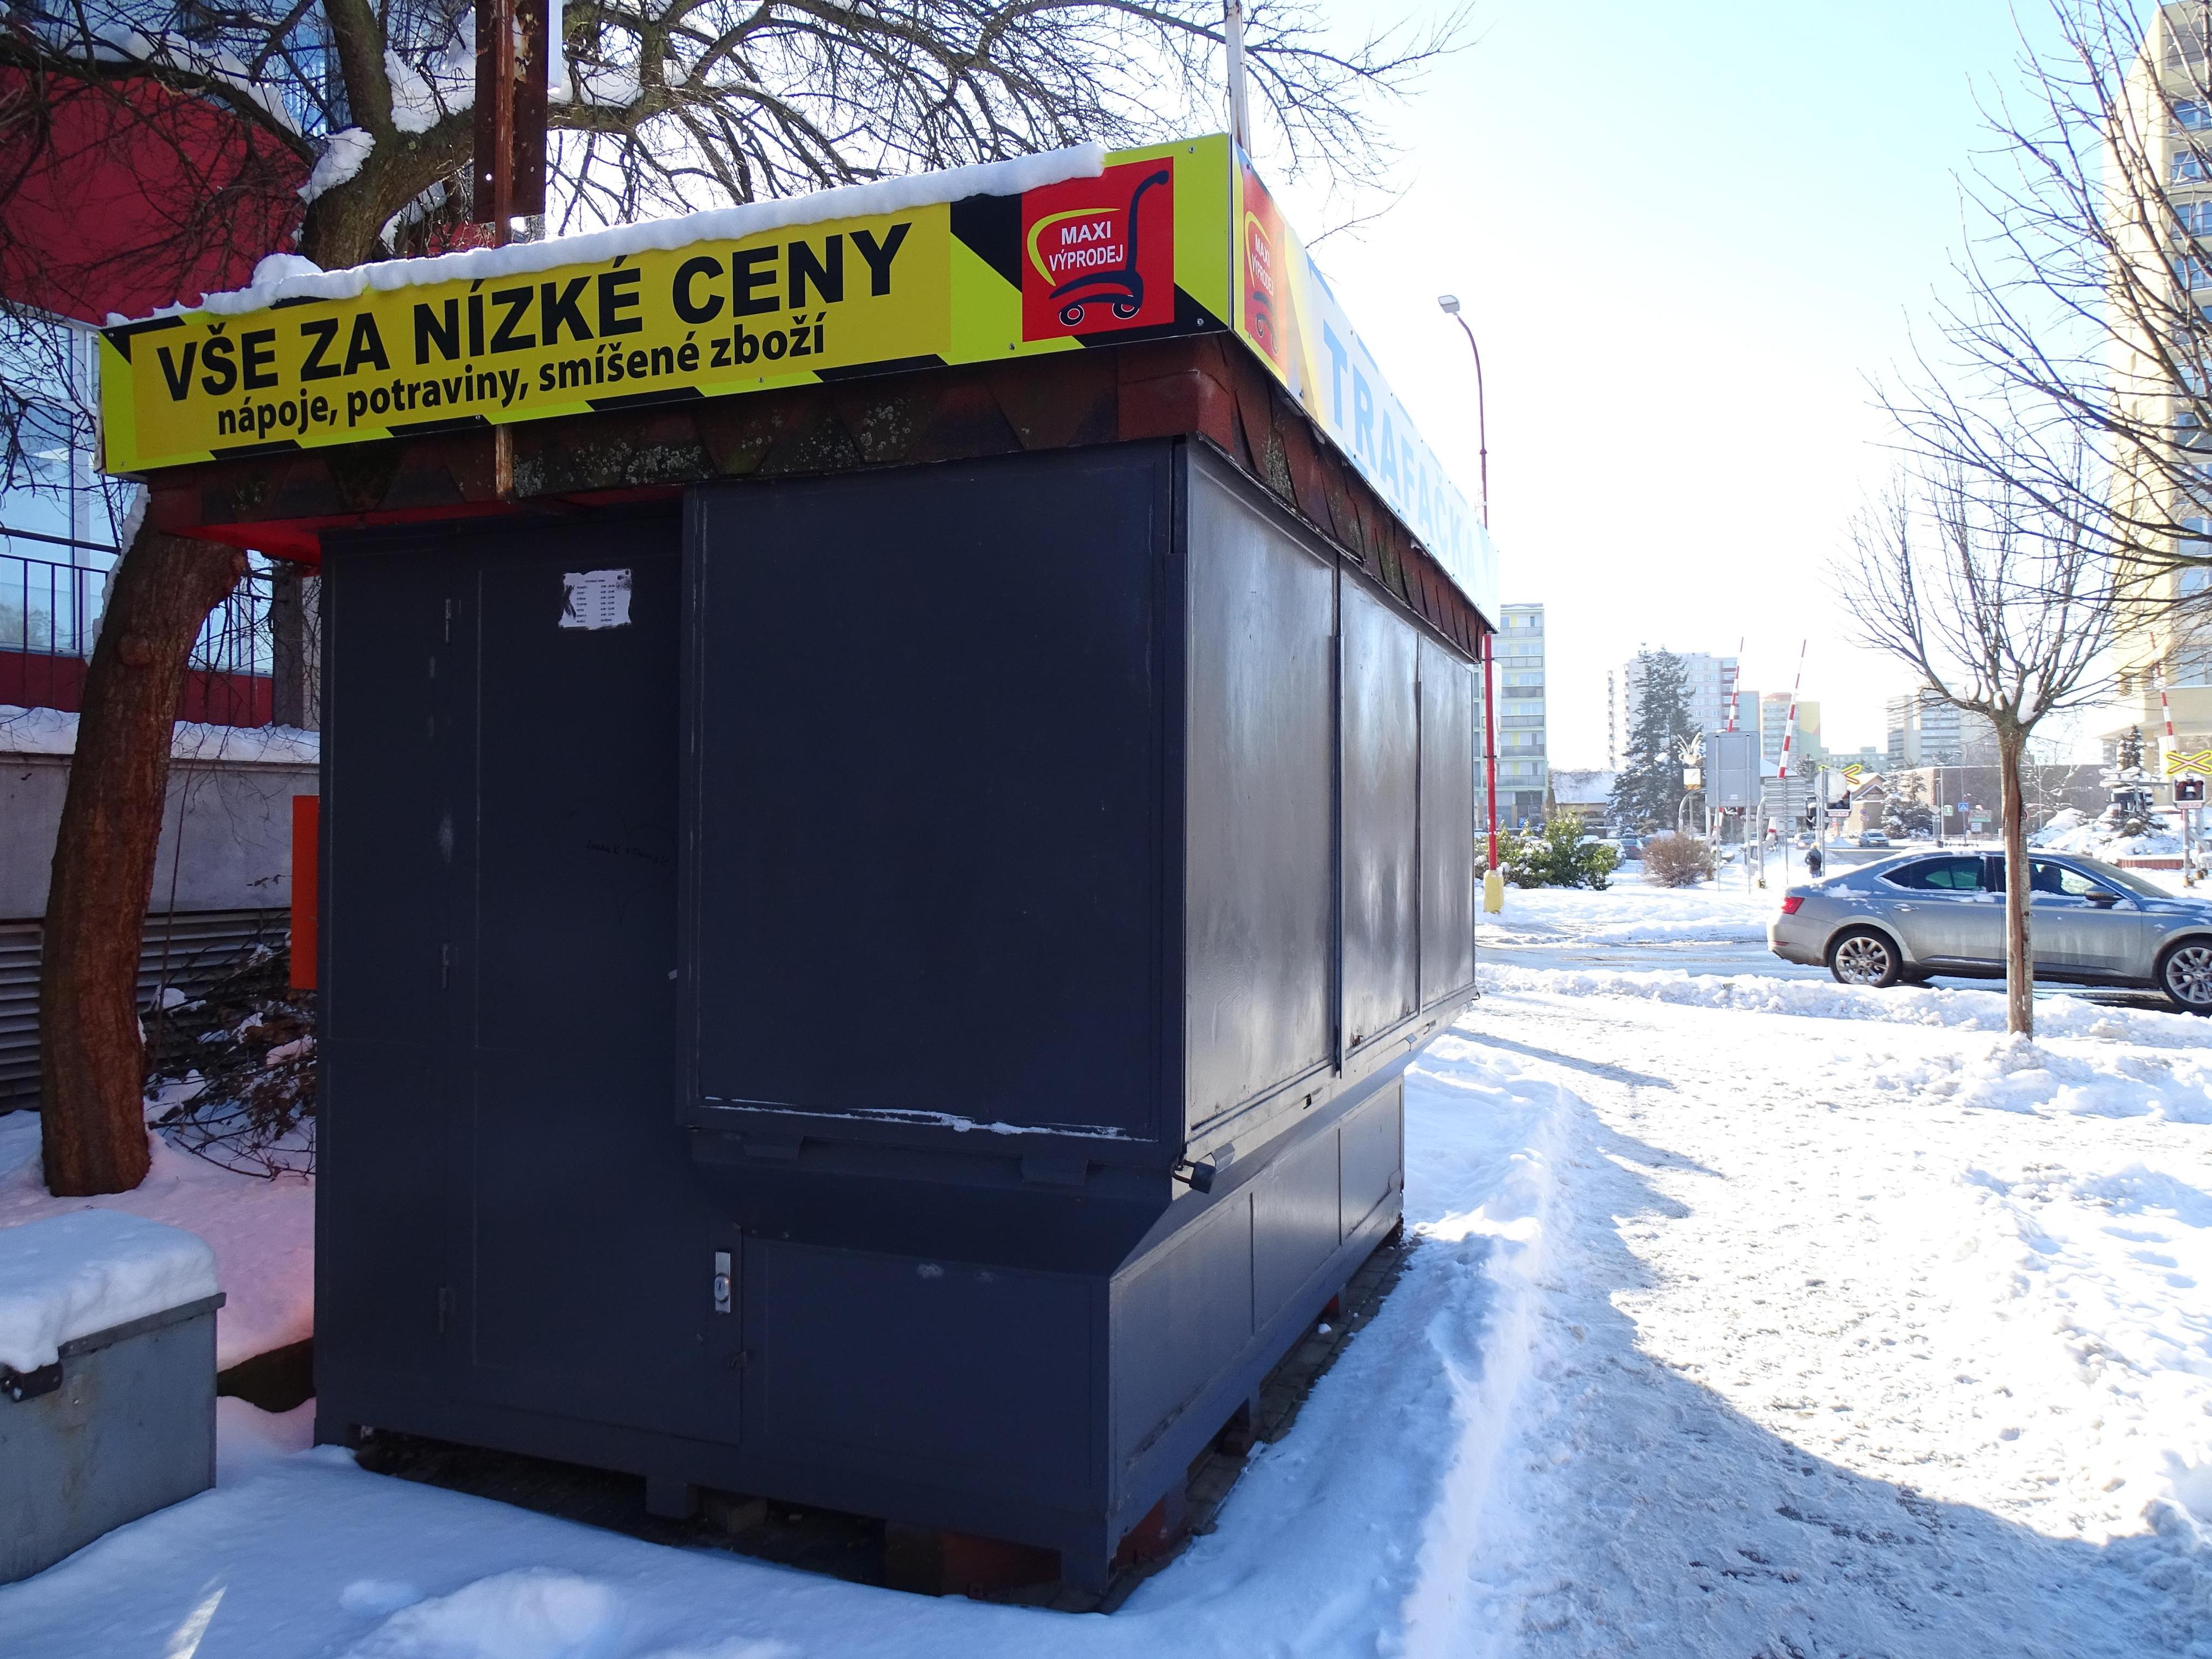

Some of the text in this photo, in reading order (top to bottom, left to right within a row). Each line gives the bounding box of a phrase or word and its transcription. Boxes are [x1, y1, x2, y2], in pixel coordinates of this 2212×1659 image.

[1061, 221, 1111, 246] MAXI
[1255, 233, 1270, 269] MAXI
[1049, 244, 1123, 272] VÝPRODEJ
[1251, 253, 1274, 297] VÝPRODEJ
[156, 222, 912, 402] VŠE ZA NÍZKÉ CENY
[218, 311, 827, 440] nápoje, potraviny, smíšené zboží
[1323, 318, 1477, 585] TRAFAČKA
